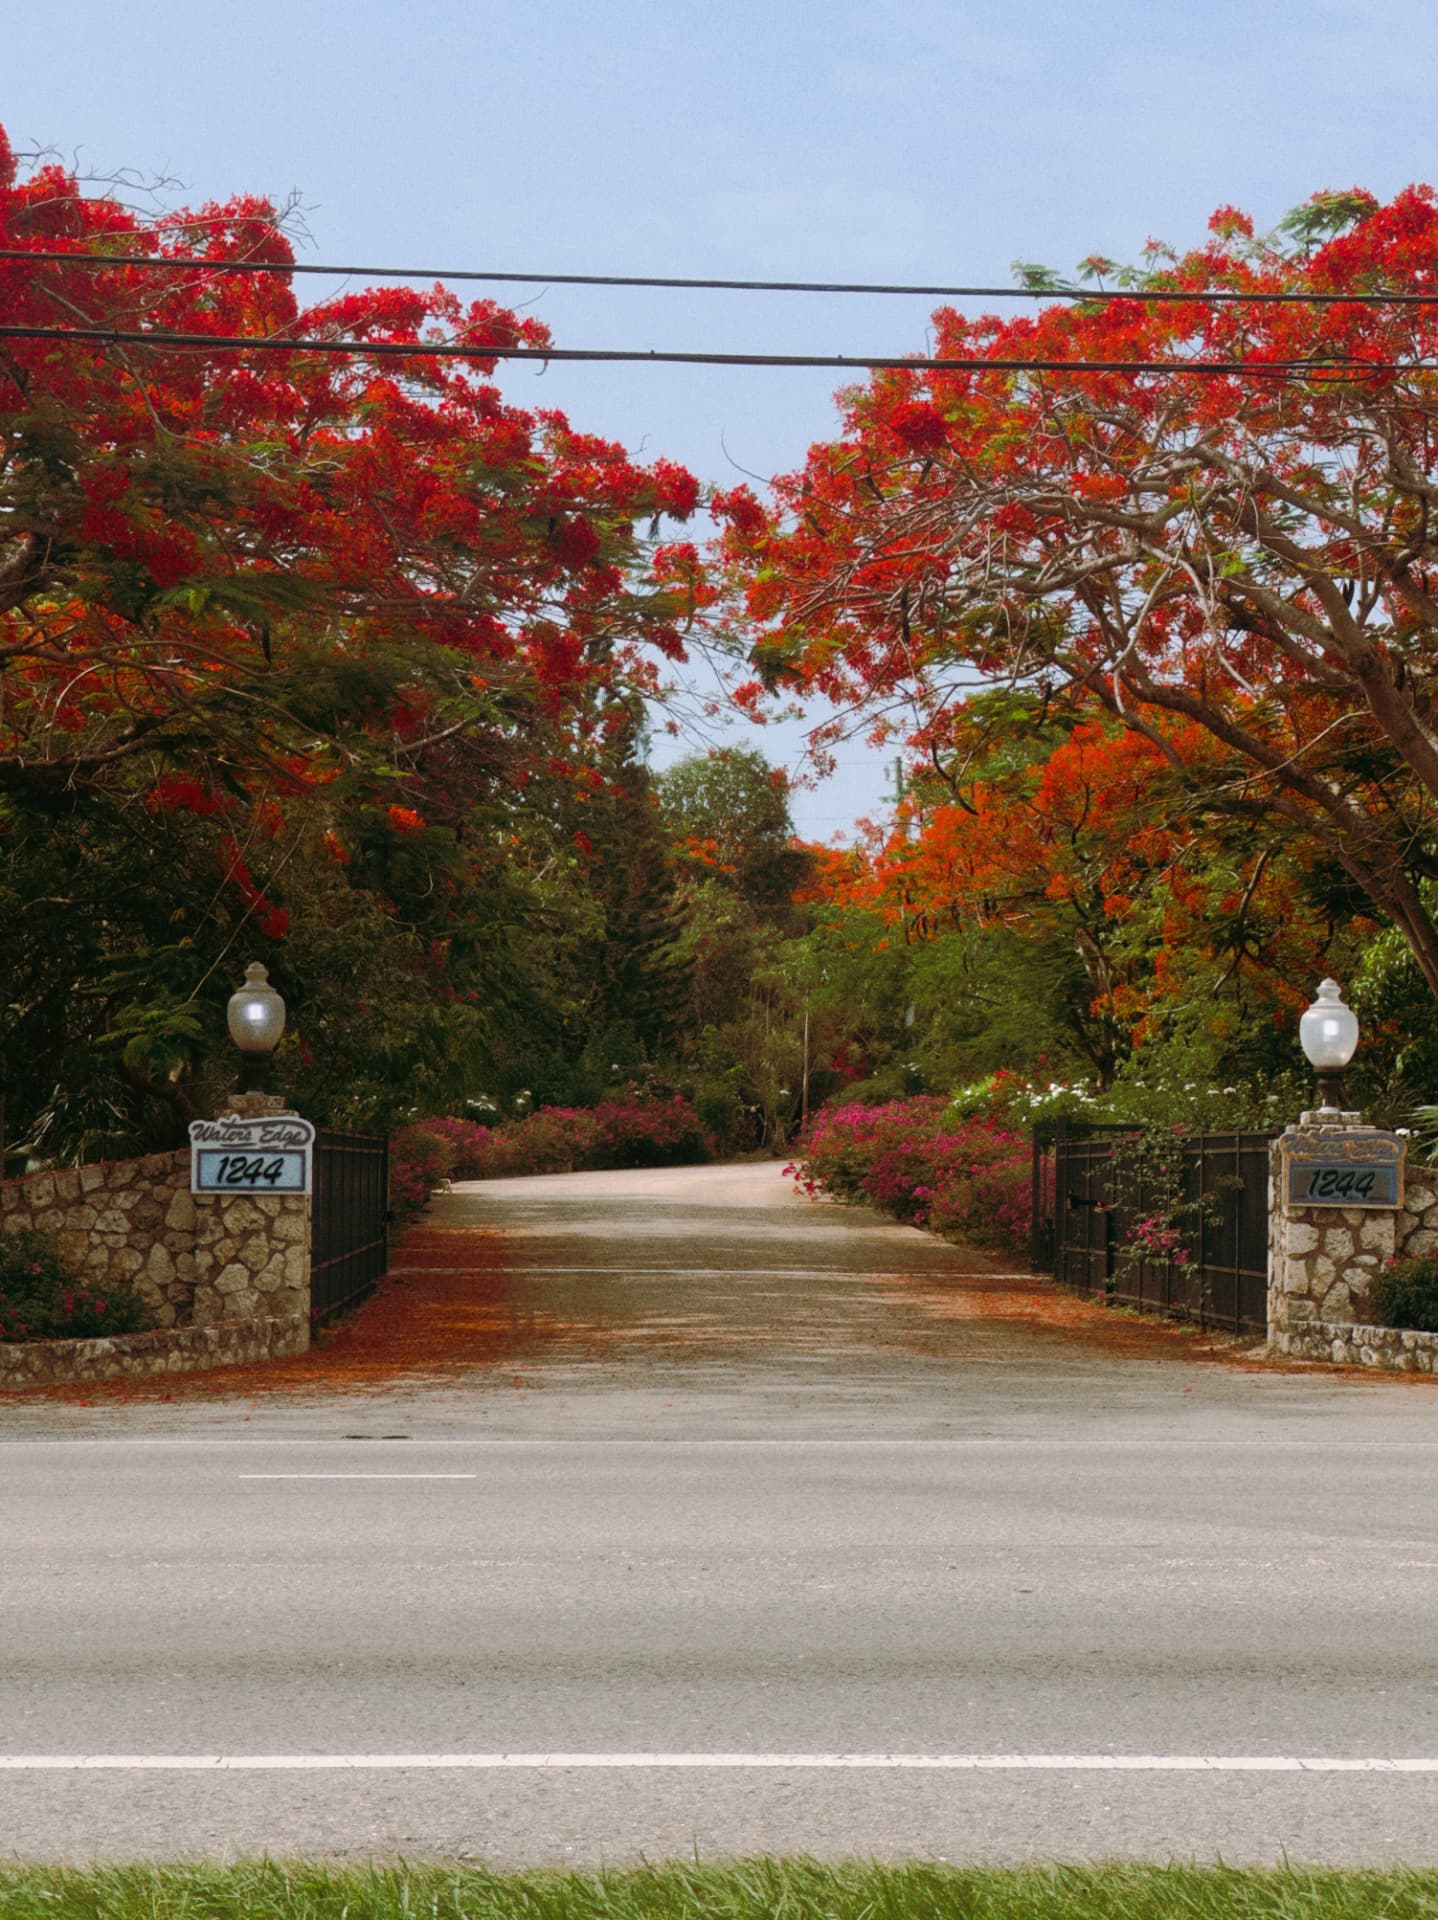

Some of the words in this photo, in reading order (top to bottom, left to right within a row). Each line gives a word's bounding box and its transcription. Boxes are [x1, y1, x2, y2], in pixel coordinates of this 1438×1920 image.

[259, 1124, 307, 1148] Edge
[217, 1156, 285, 1184] 1244
[1308, 1169, 1376, 1198] 1244
